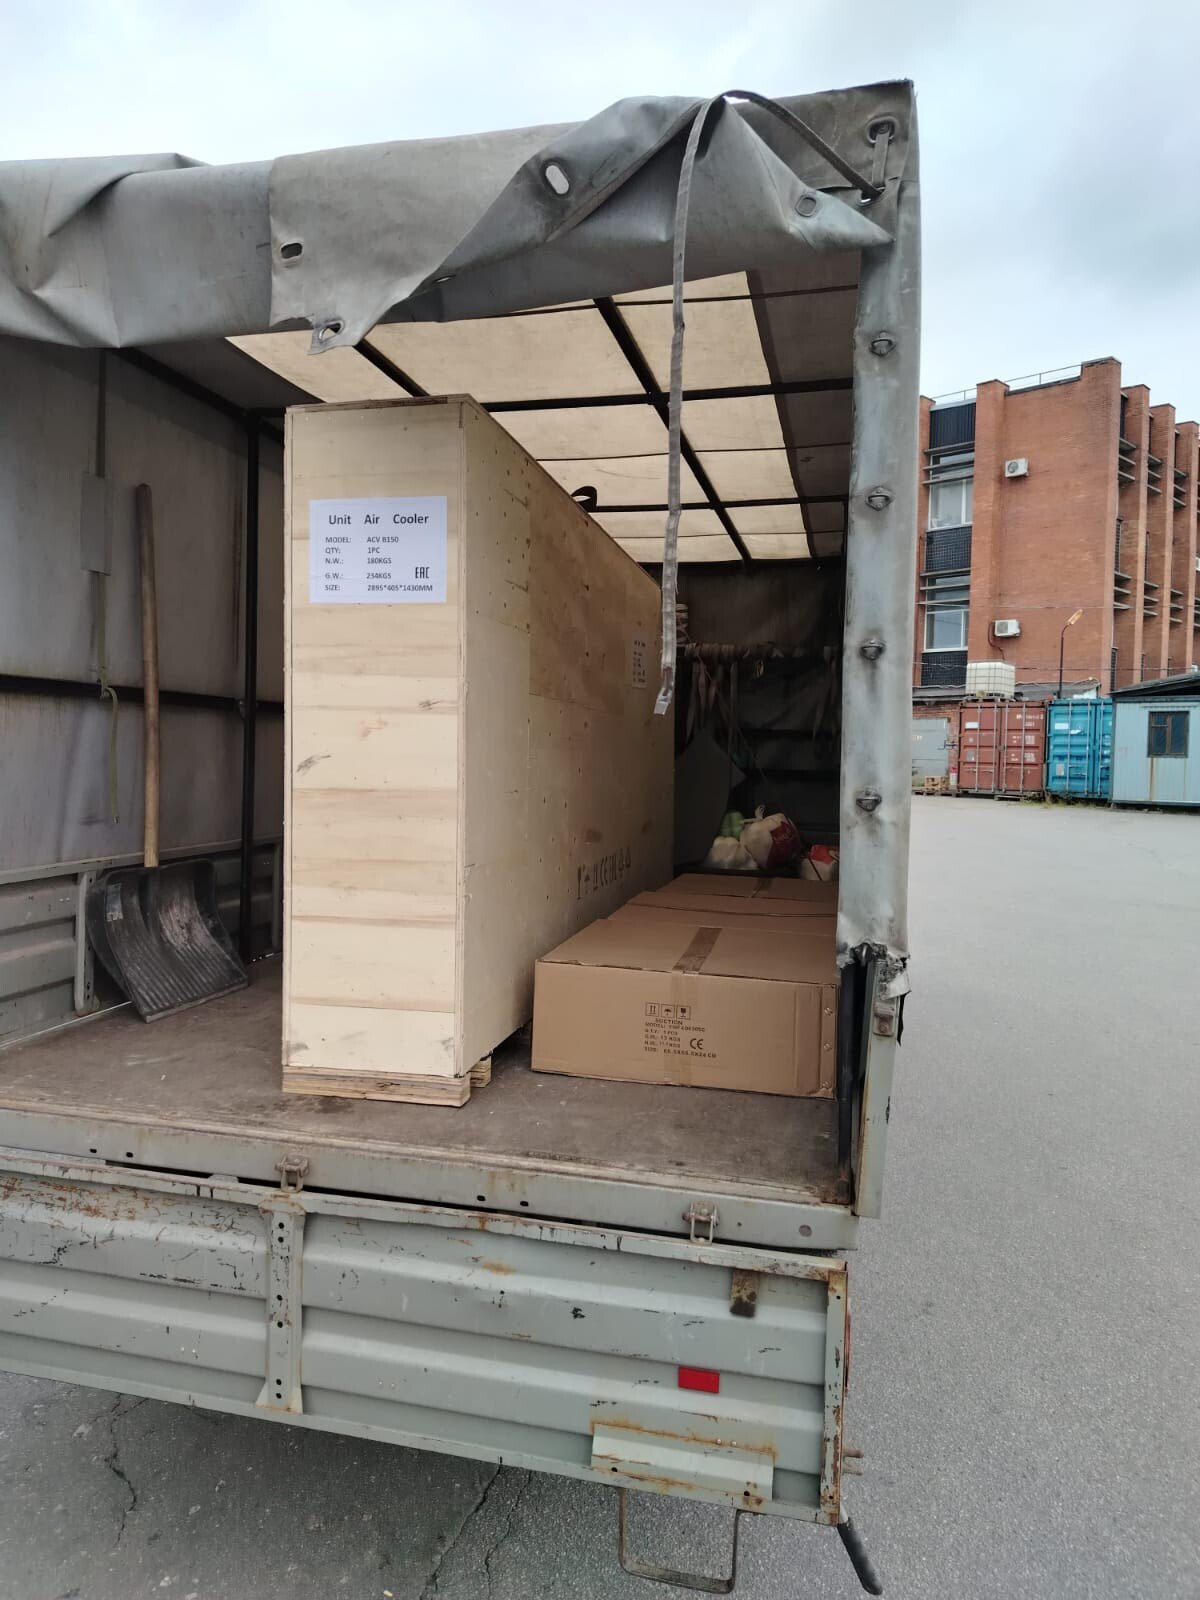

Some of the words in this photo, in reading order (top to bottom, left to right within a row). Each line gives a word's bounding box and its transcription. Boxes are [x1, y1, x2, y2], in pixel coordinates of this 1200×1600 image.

[328, 514, 352, 525] Unit
[364, 514, 380, 524] Air
[392, 513, 429, 524] Cooler
[690, 1038, 704, 1050] CE
